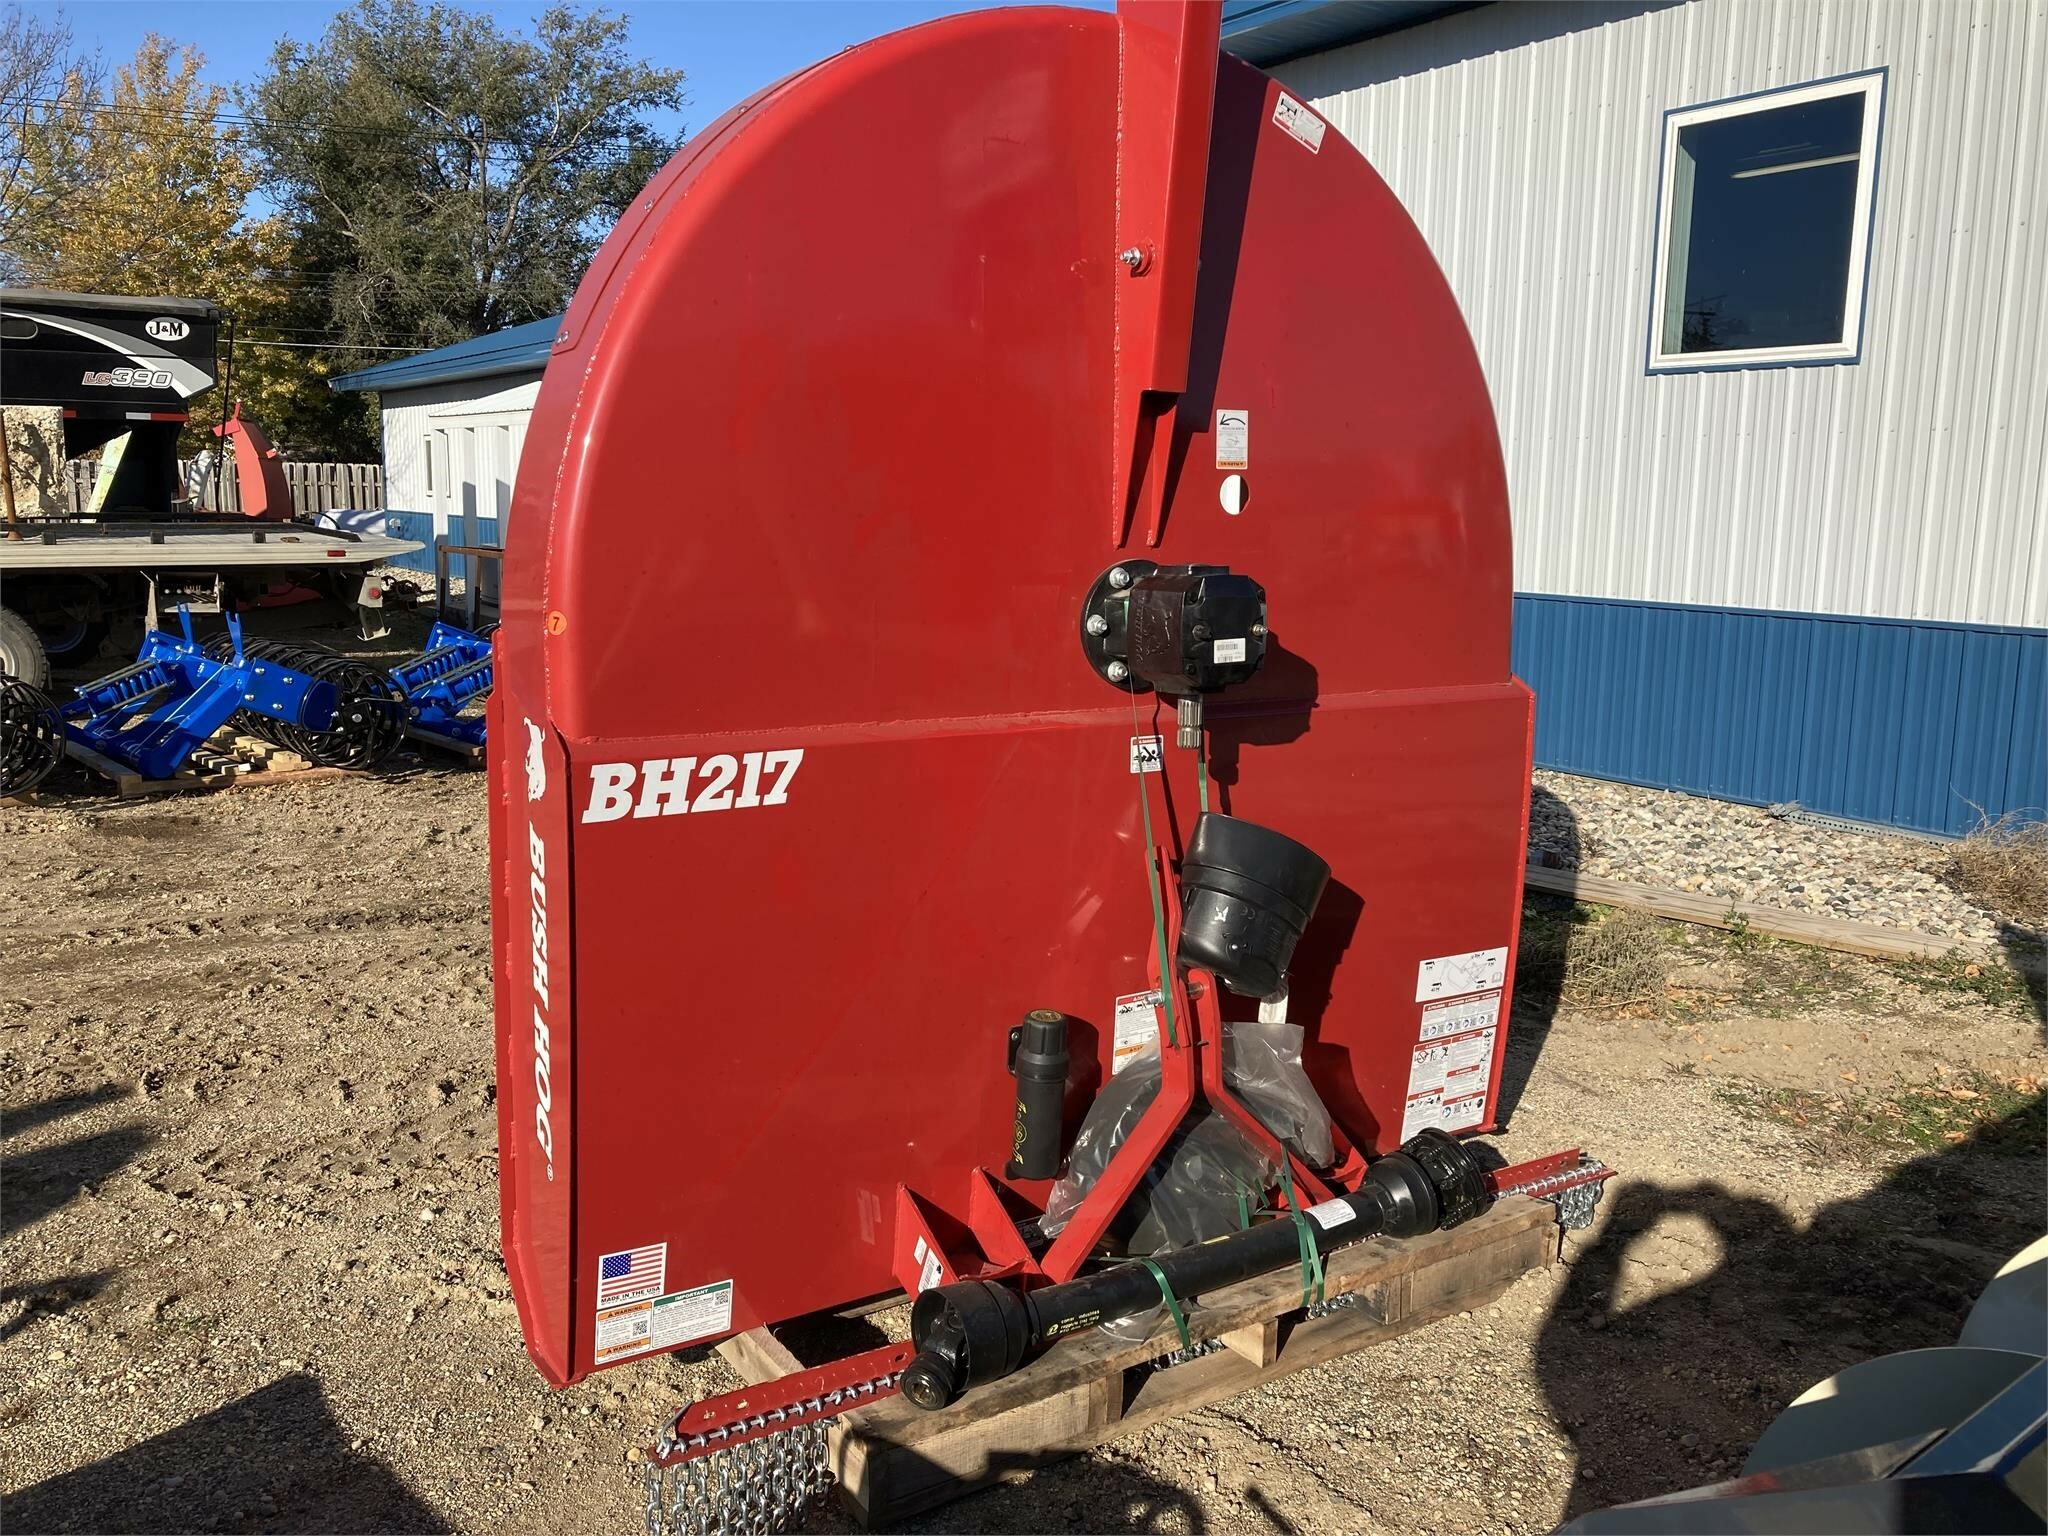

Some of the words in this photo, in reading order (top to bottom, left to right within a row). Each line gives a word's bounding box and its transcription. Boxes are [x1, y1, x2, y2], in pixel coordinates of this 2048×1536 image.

[149, 321, 183, 337] J&M
[553, 616, 560, 631] 7
[581, 748, 805, 824] BH217
[529, 820, 549, 1012] BUSH
[600, 1295, 620, 1303] MADE
[674, 1288, 709, 1301] IMPORTANT
[614, 1305, 643, 1316] WARNING
[613, 1341, 642, 1352] WARNING
